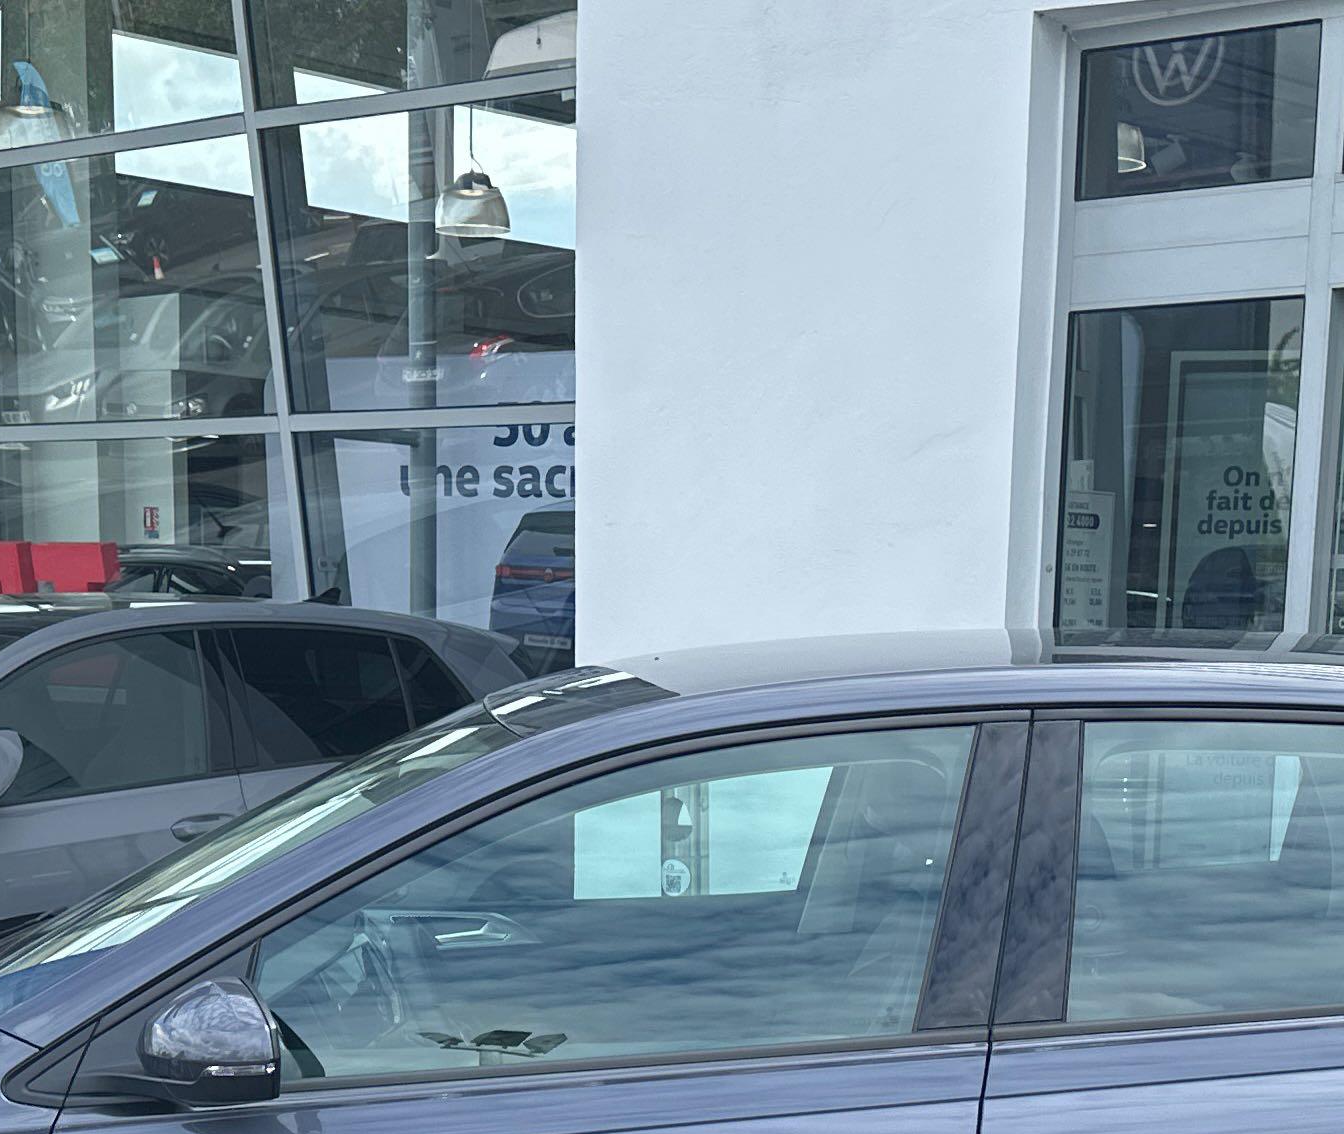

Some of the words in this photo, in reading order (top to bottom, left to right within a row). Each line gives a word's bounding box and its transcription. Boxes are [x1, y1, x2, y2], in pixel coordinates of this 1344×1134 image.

[1223, 466, 1260, 487] On
[1206, 489, 1252, 511] fait
[1197, 512, 1282, 540] depuis
